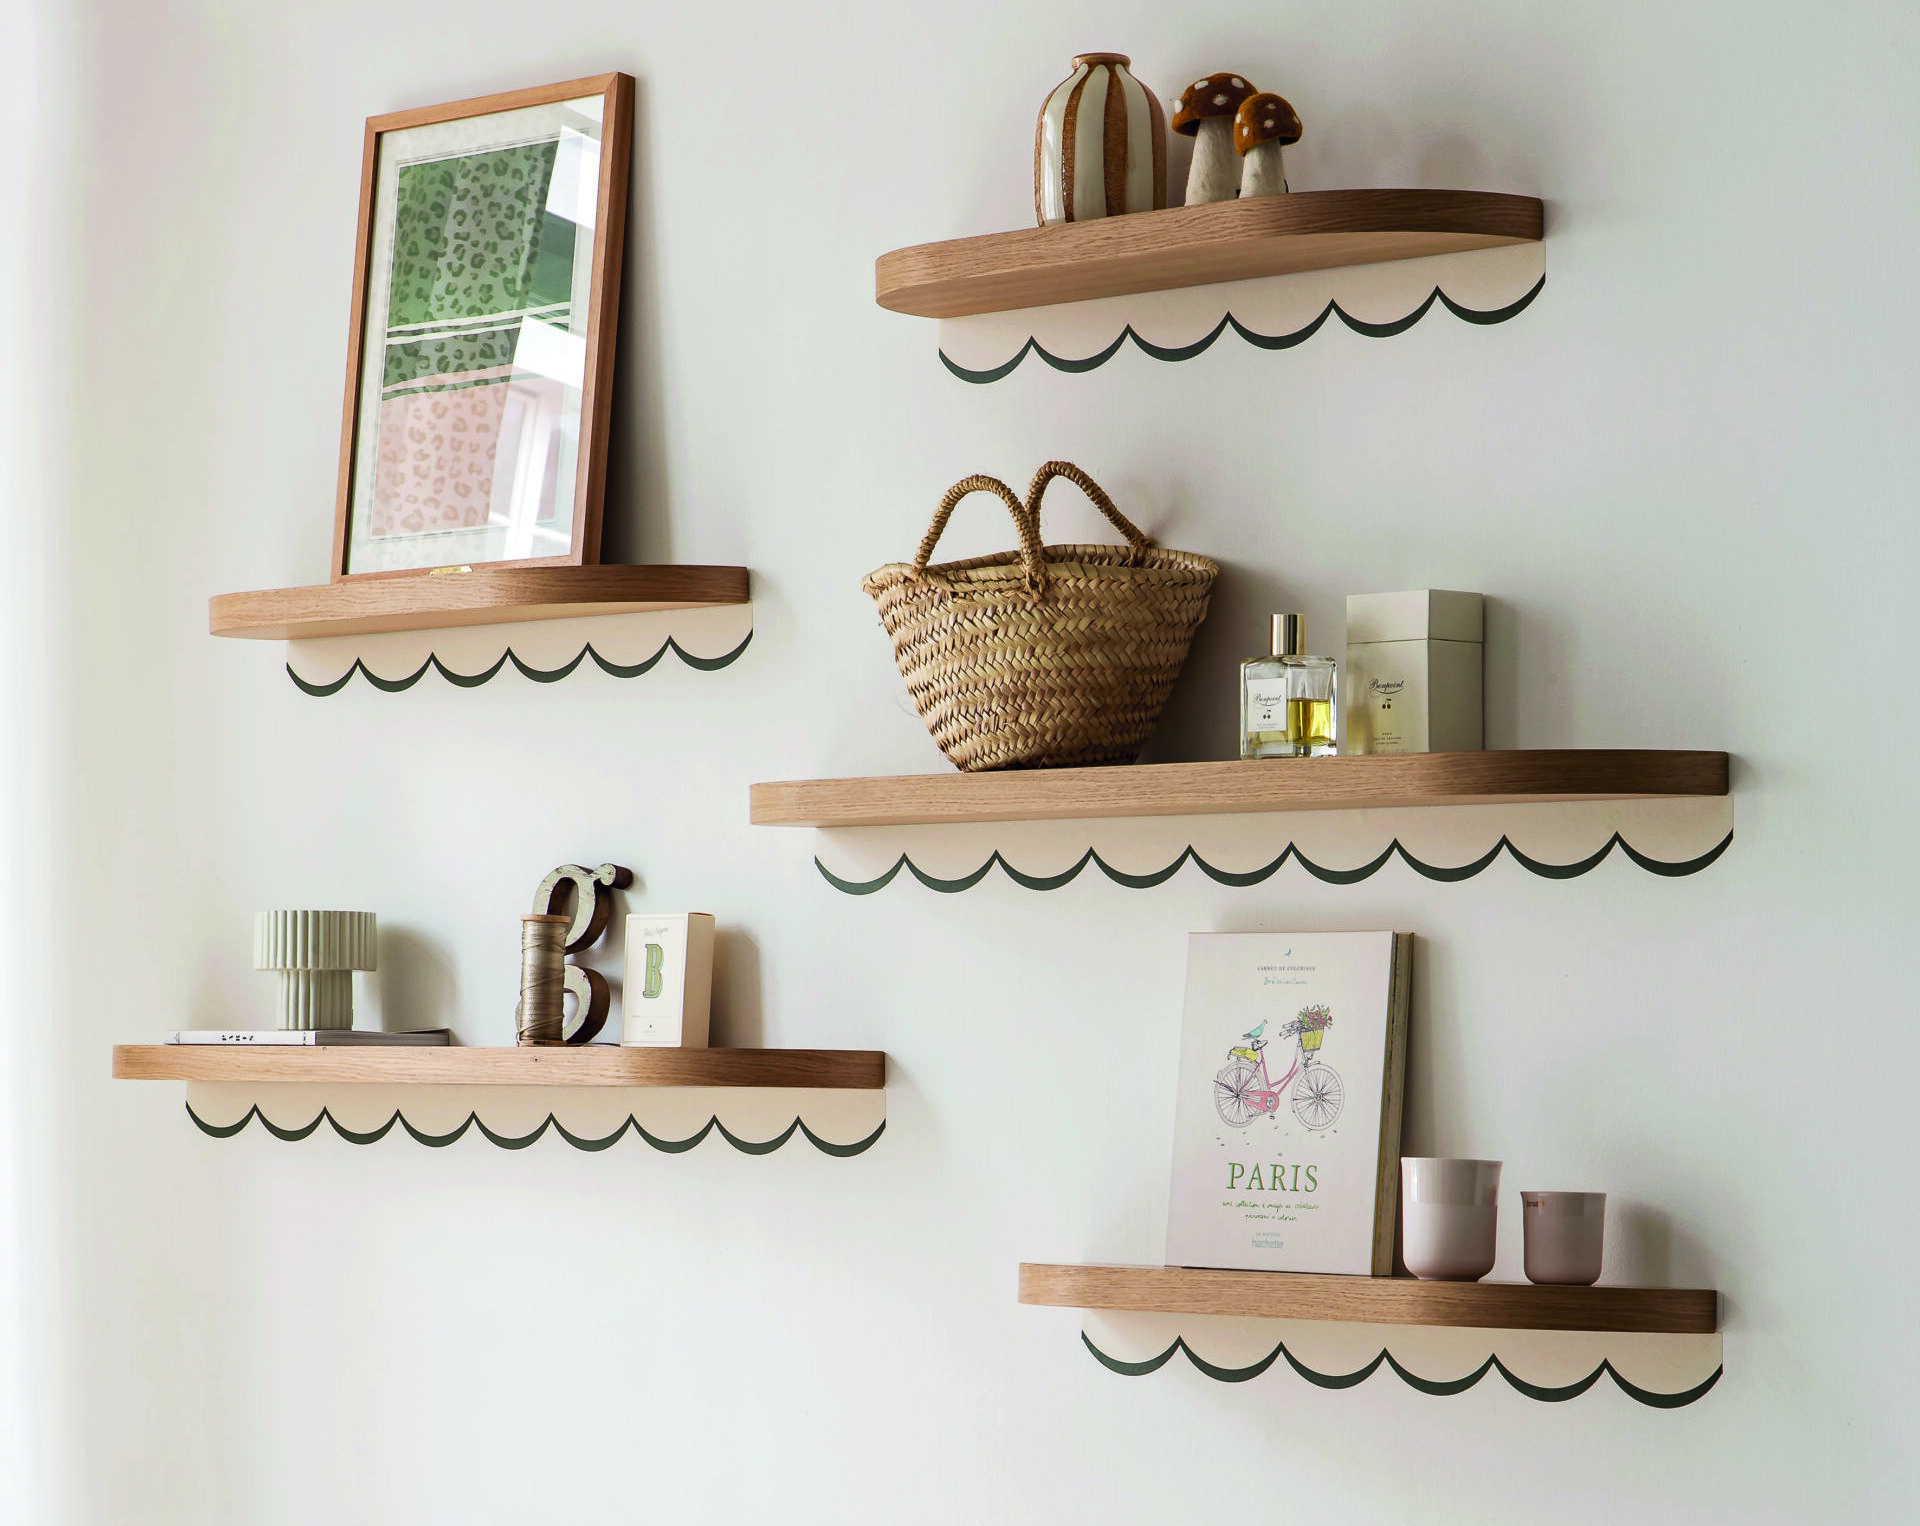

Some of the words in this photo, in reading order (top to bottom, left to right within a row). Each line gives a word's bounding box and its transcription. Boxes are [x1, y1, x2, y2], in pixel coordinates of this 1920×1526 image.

[1369, 678, 1404, 694] Bonpoint
[642, 943, 664, 999] B
[1226, 1162, 1319, 1193] PARIS
[1251, 1237, 1284, 1249] hachette
